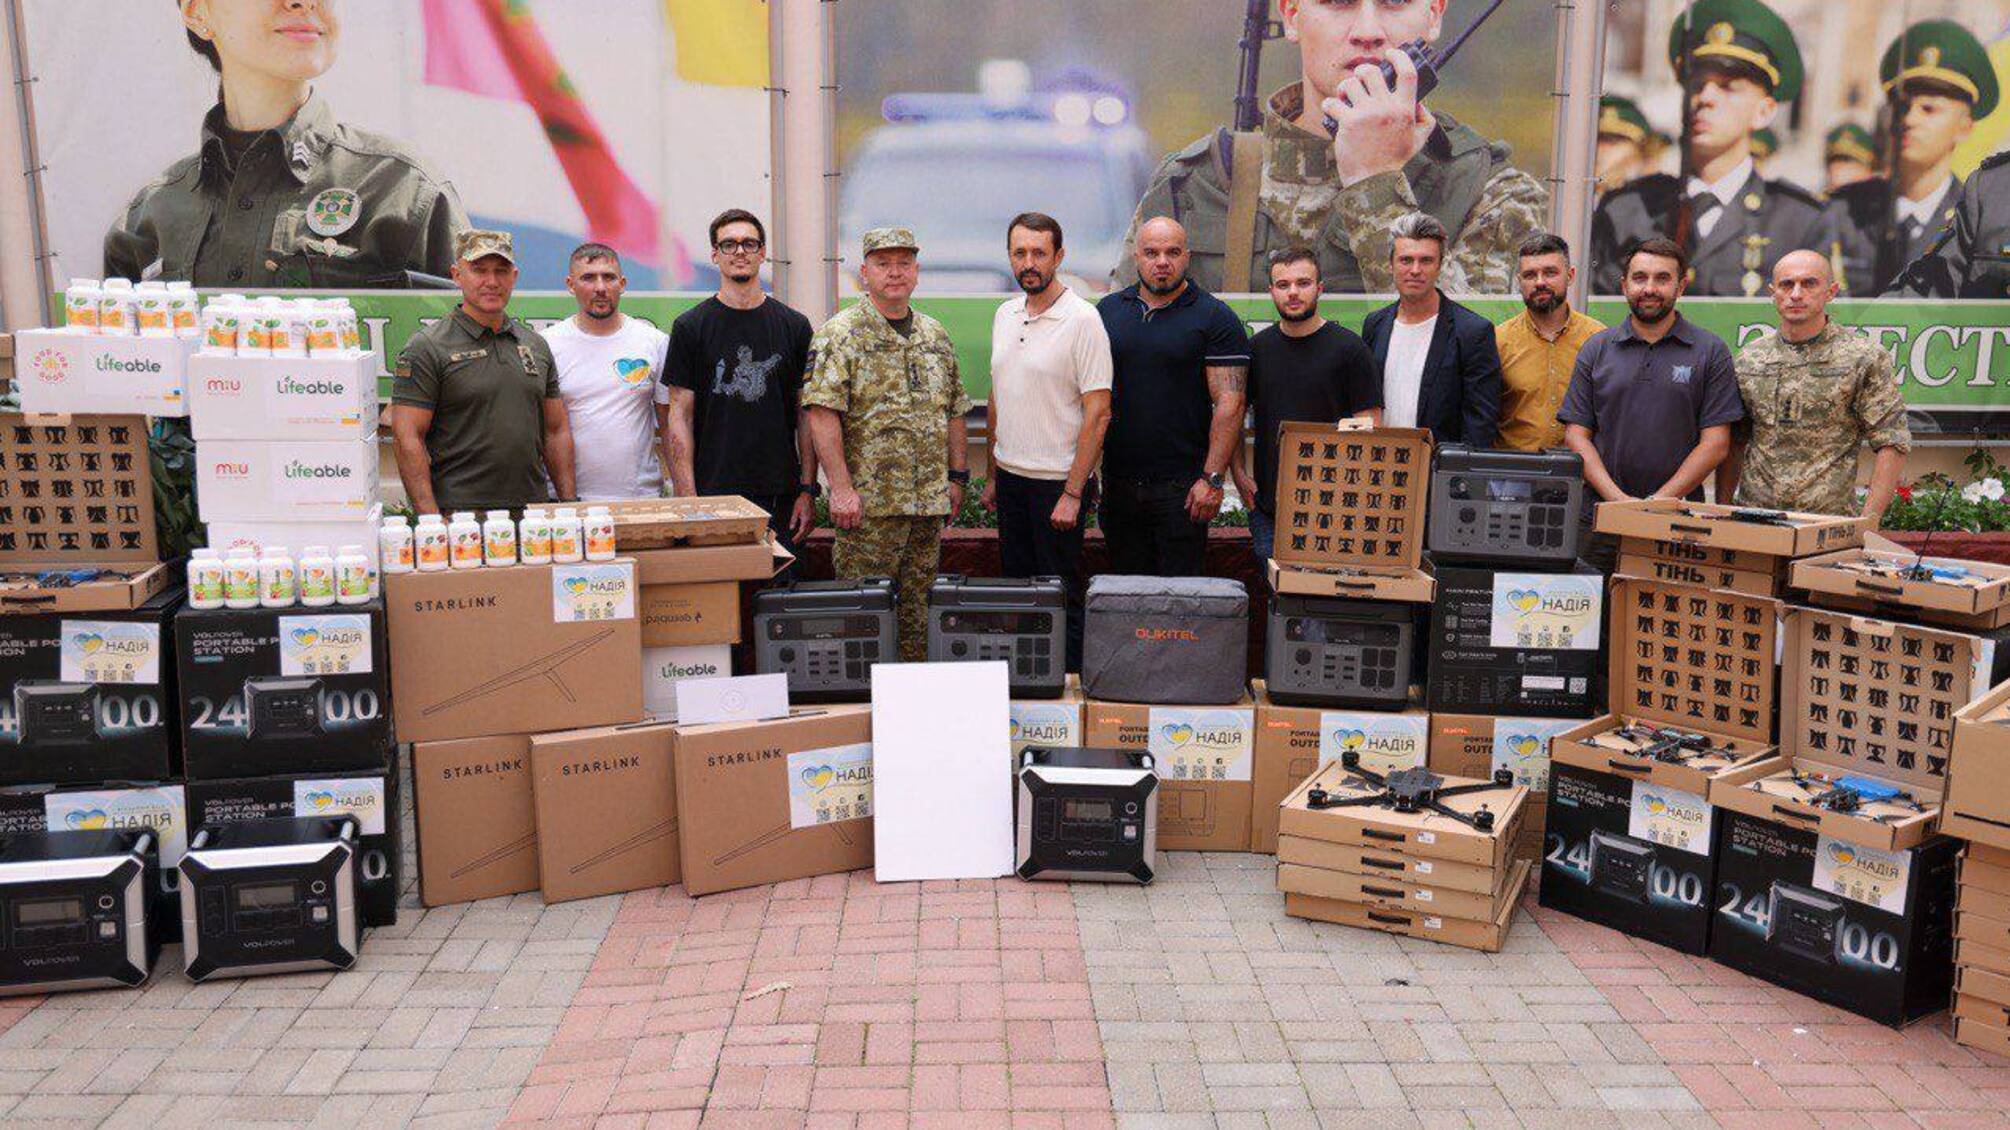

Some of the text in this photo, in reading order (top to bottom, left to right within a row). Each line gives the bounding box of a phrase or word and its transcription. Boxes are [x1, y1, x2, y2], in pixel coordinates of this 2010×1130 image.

[96, 353, 161, 373] Lifeable
[276, 376, 345, 395] Lifeable
[285, 460, 351, 478] Lifeable
[1654, 562, 1706, 583] ТІНЬ
[590, 580, 625, 592] НАДІЯ
[414, 596, 497, 612] STARLINK
[1542, 599, 1591, 612] НАДІЯ
[193, 638, 266, 648] PORTABLE
[322, 632, 363, 645] НАДІЯ
[105, 641, 149, 653] НАДІЯ
[193, 646, 255, 655] STATION
[662, 662, 717, 678] Lifeable
[325, 689, 379, 721] 00
[1023, 726, 1068, 739] НАДІЯ
[1196, 731, 1242, 745] НАДІЯ
[1368, 739, 1415, 751] НАДІЯ
[562, 755, 641, 776] STARLINK
[707, 748, 782, 767] STARLINK
[443, 758, 524, 780] STARLINK
[836, 767, 873, 783] НАДІ
[204, 803, 277, 814] PORTABLE
[337, 795, 376, 806] НАДІЯ
[205, 811, 266, 823] STATION
[1667, 805, 1704, 824] НАДІЯ
[1857, 858, 1900, 880] НАДІЯ
